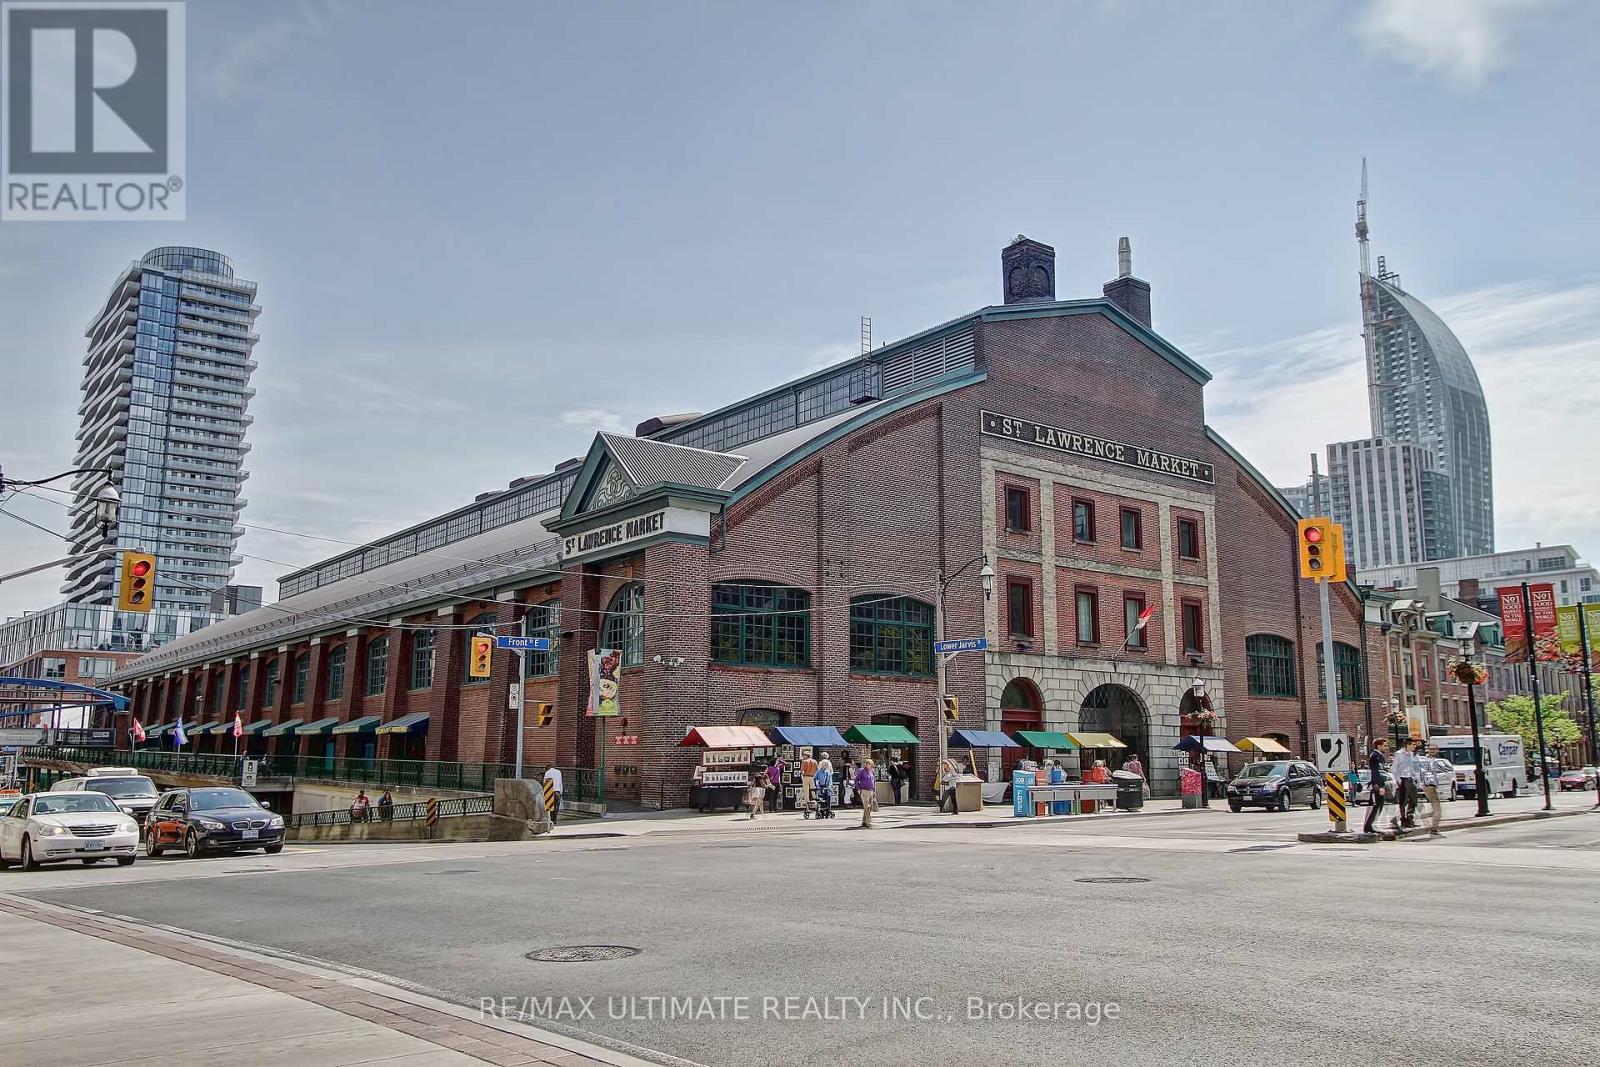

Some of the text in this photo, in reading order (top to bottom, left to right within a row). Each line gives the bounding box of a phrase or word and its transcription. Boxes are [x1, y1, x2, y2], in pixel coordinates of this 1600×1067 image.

[1034, 425, 1125, 461] LAWRENCE
[1136, 450, 1199, 478] MARKET
[577, 524, 623, 552] LAWRENCE
[626, 511, 665, 539] MARKET
[508, 637, 528, 647] Front
[535, 639, 539, 647] E
[940, 643, 958, 651] Lower
[959, 640, 977, 649] Jarvis
